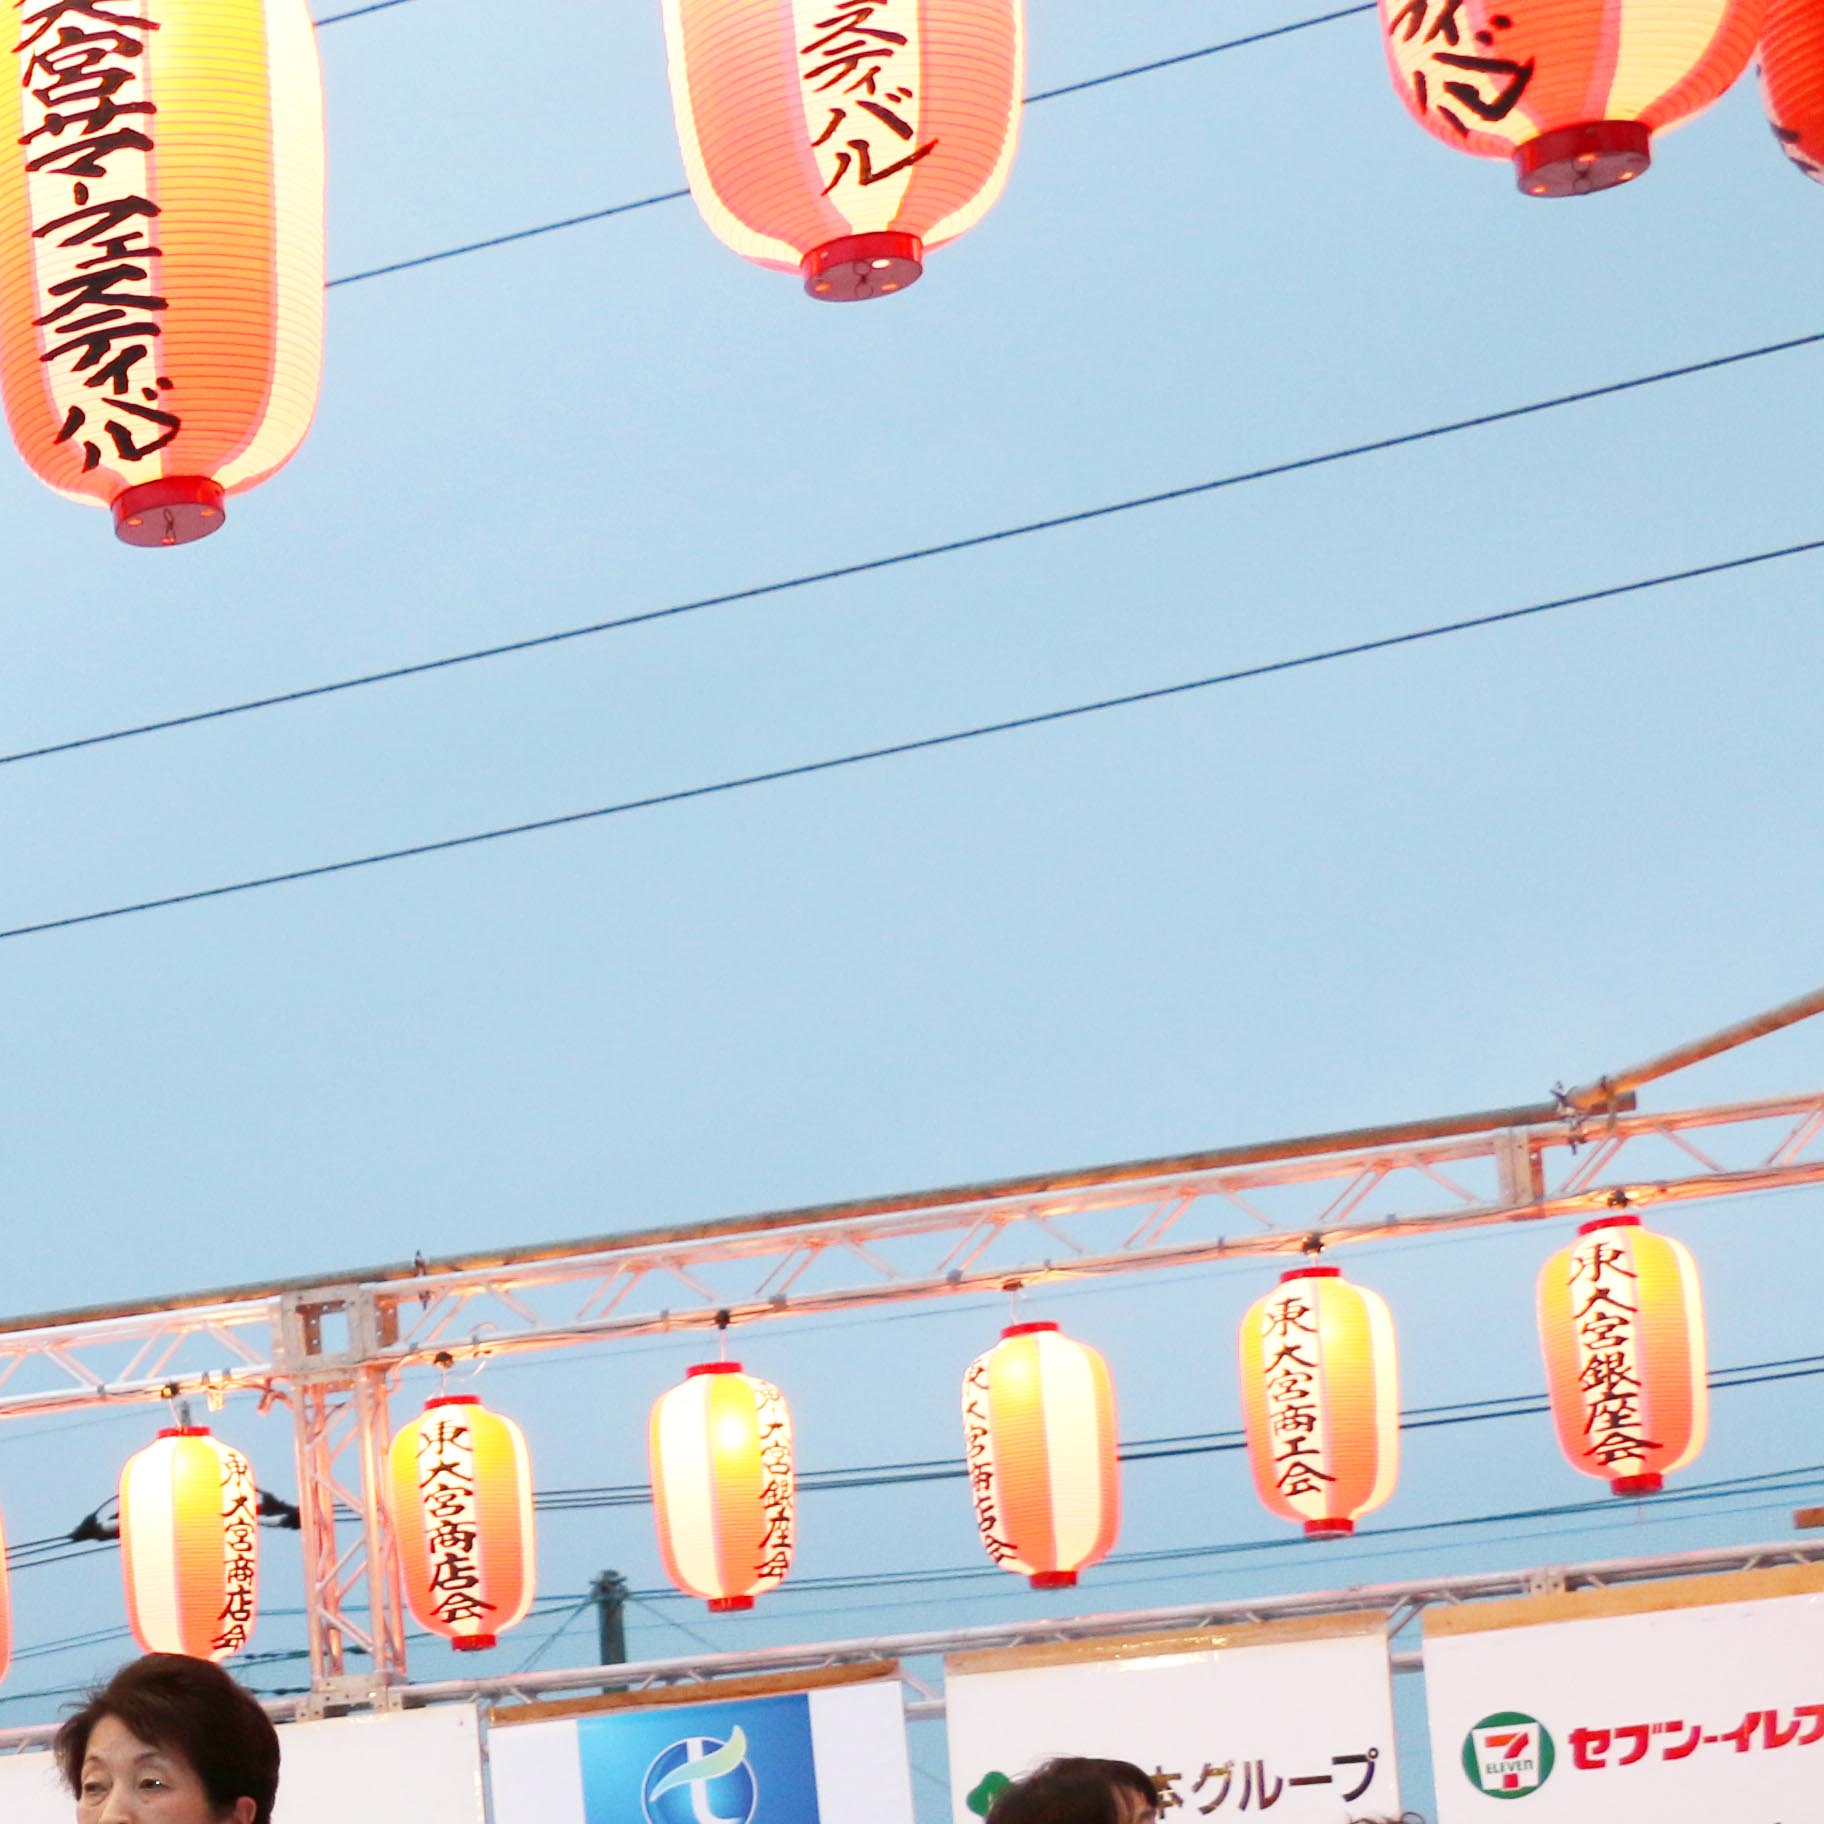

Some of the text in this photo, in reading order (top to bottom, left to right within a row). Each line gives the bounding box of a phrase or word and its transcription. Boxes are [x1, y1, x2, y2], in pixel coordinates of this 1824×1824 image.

[1262, 1298, 1336, 1498] 東大宮商工会
[1569, 1240, 1664, 1467] 東大宮銀座会
[211, 1453, 254, 1652] 東大宮商店会
[418, 1419, 496, 1625] 東大宮商店会
